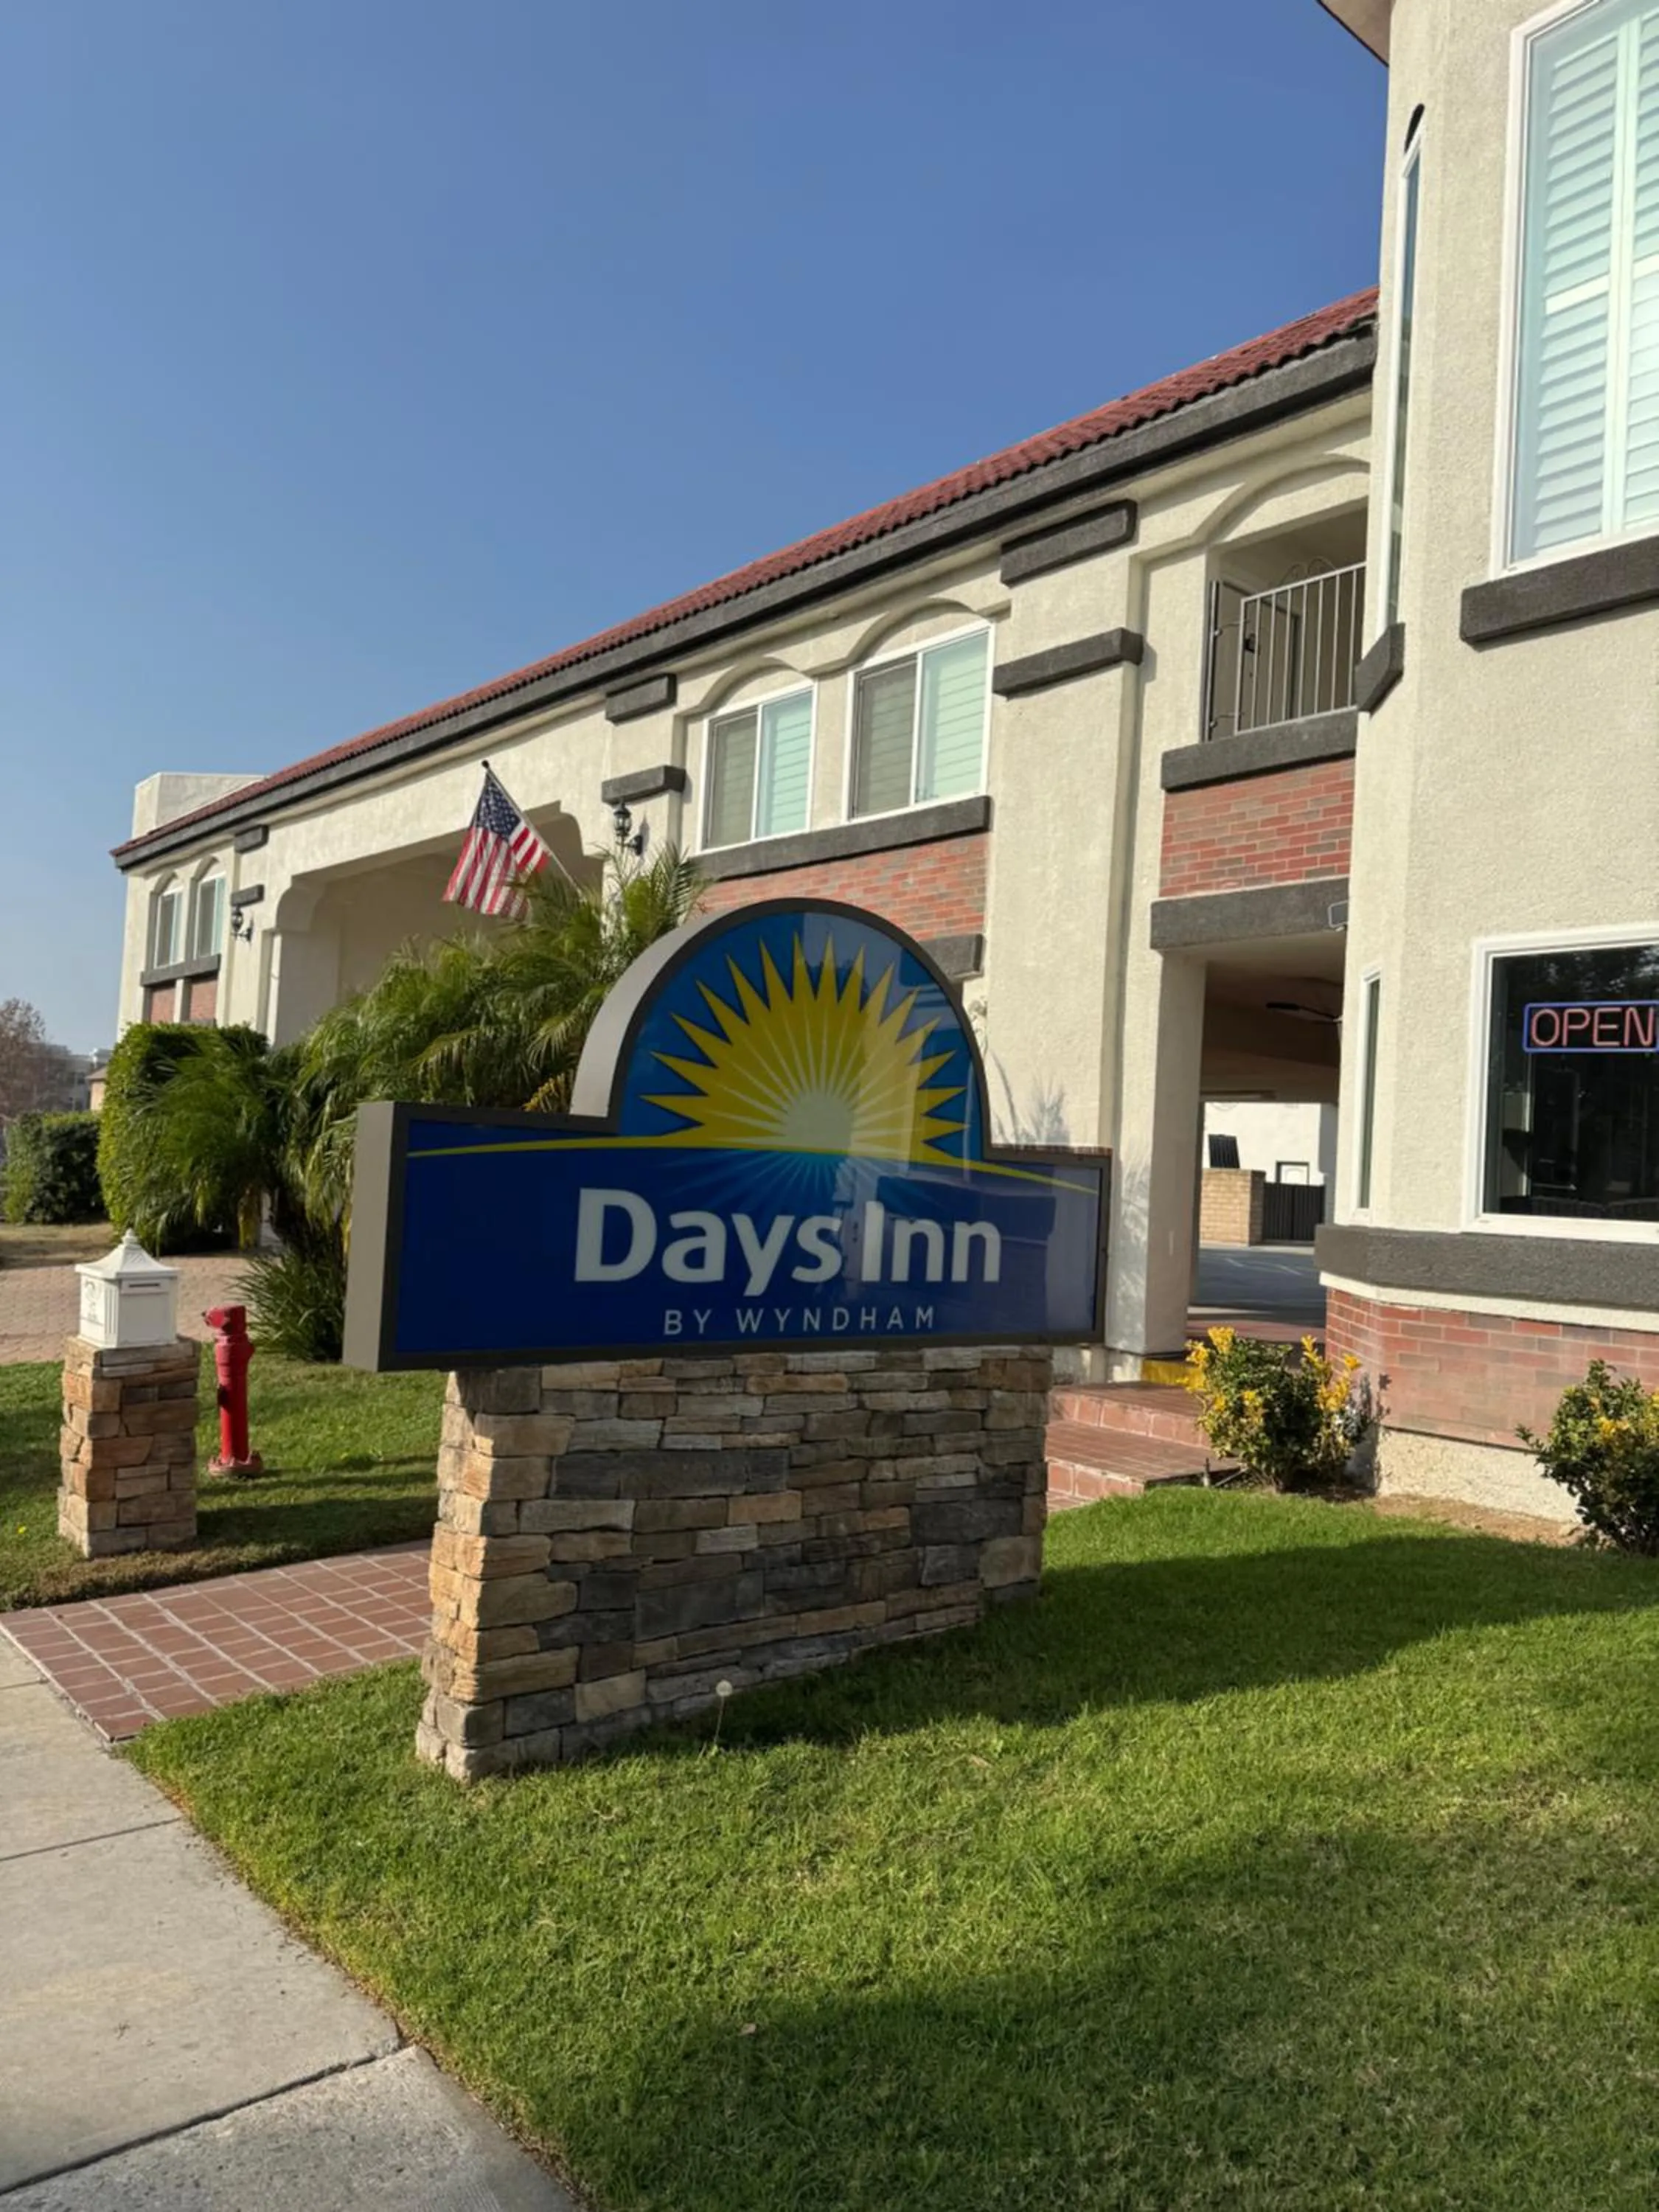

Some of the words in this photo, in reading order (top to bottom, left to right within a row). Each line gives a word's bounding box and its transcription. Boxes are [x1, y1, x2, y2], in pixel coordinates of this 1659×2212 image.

[1531, 1007, 1655, 1046] OPEN
[575, 1188, 843, 1296] Days
[860, 1200, 1001, 1282] Inn
[664, 1309, 712, 1335] BY
[736, 1306, 933, 1333] WYNDHAM
